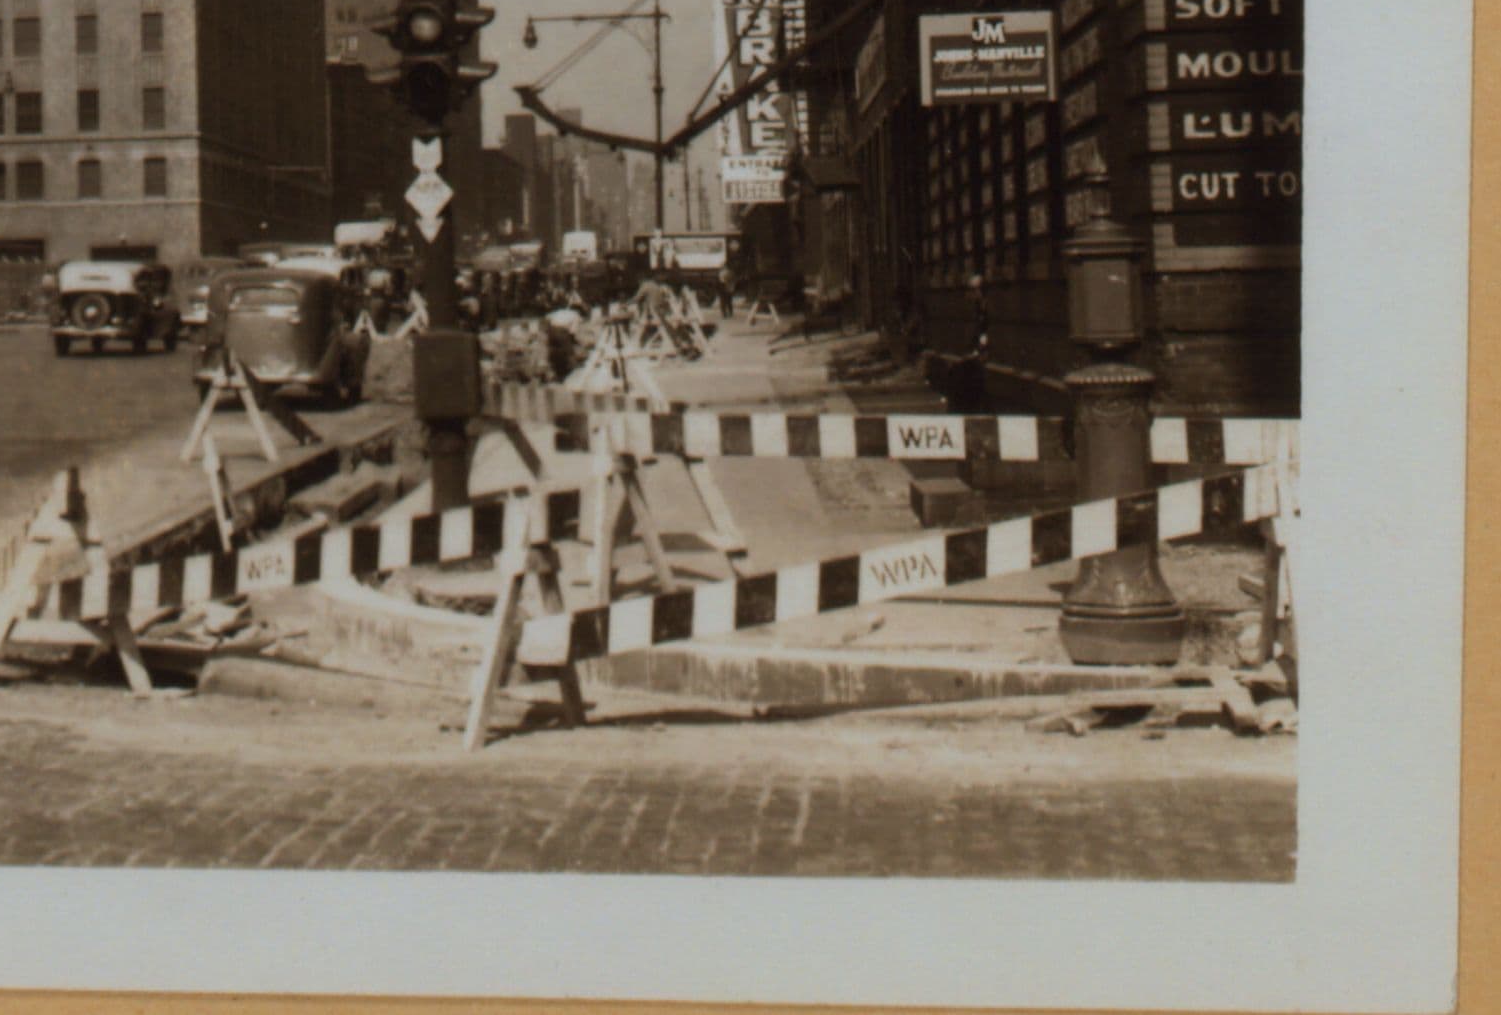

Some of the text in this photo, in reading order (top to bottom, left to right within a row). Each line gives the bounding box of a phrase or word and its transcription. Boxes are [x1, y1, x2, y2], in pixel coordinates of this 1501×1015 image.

[971, 18, 1005, 44] JM
[1177, 51, 1304, 79] MOUL
[1184, 113, 1301, 139] LUM
[1179, 171, 1297, 200] CUT TO
[898, 425, 954, 449] WPA
[244, 554, 286, 580] WPA
[869, 552, 937, 588] WPA
